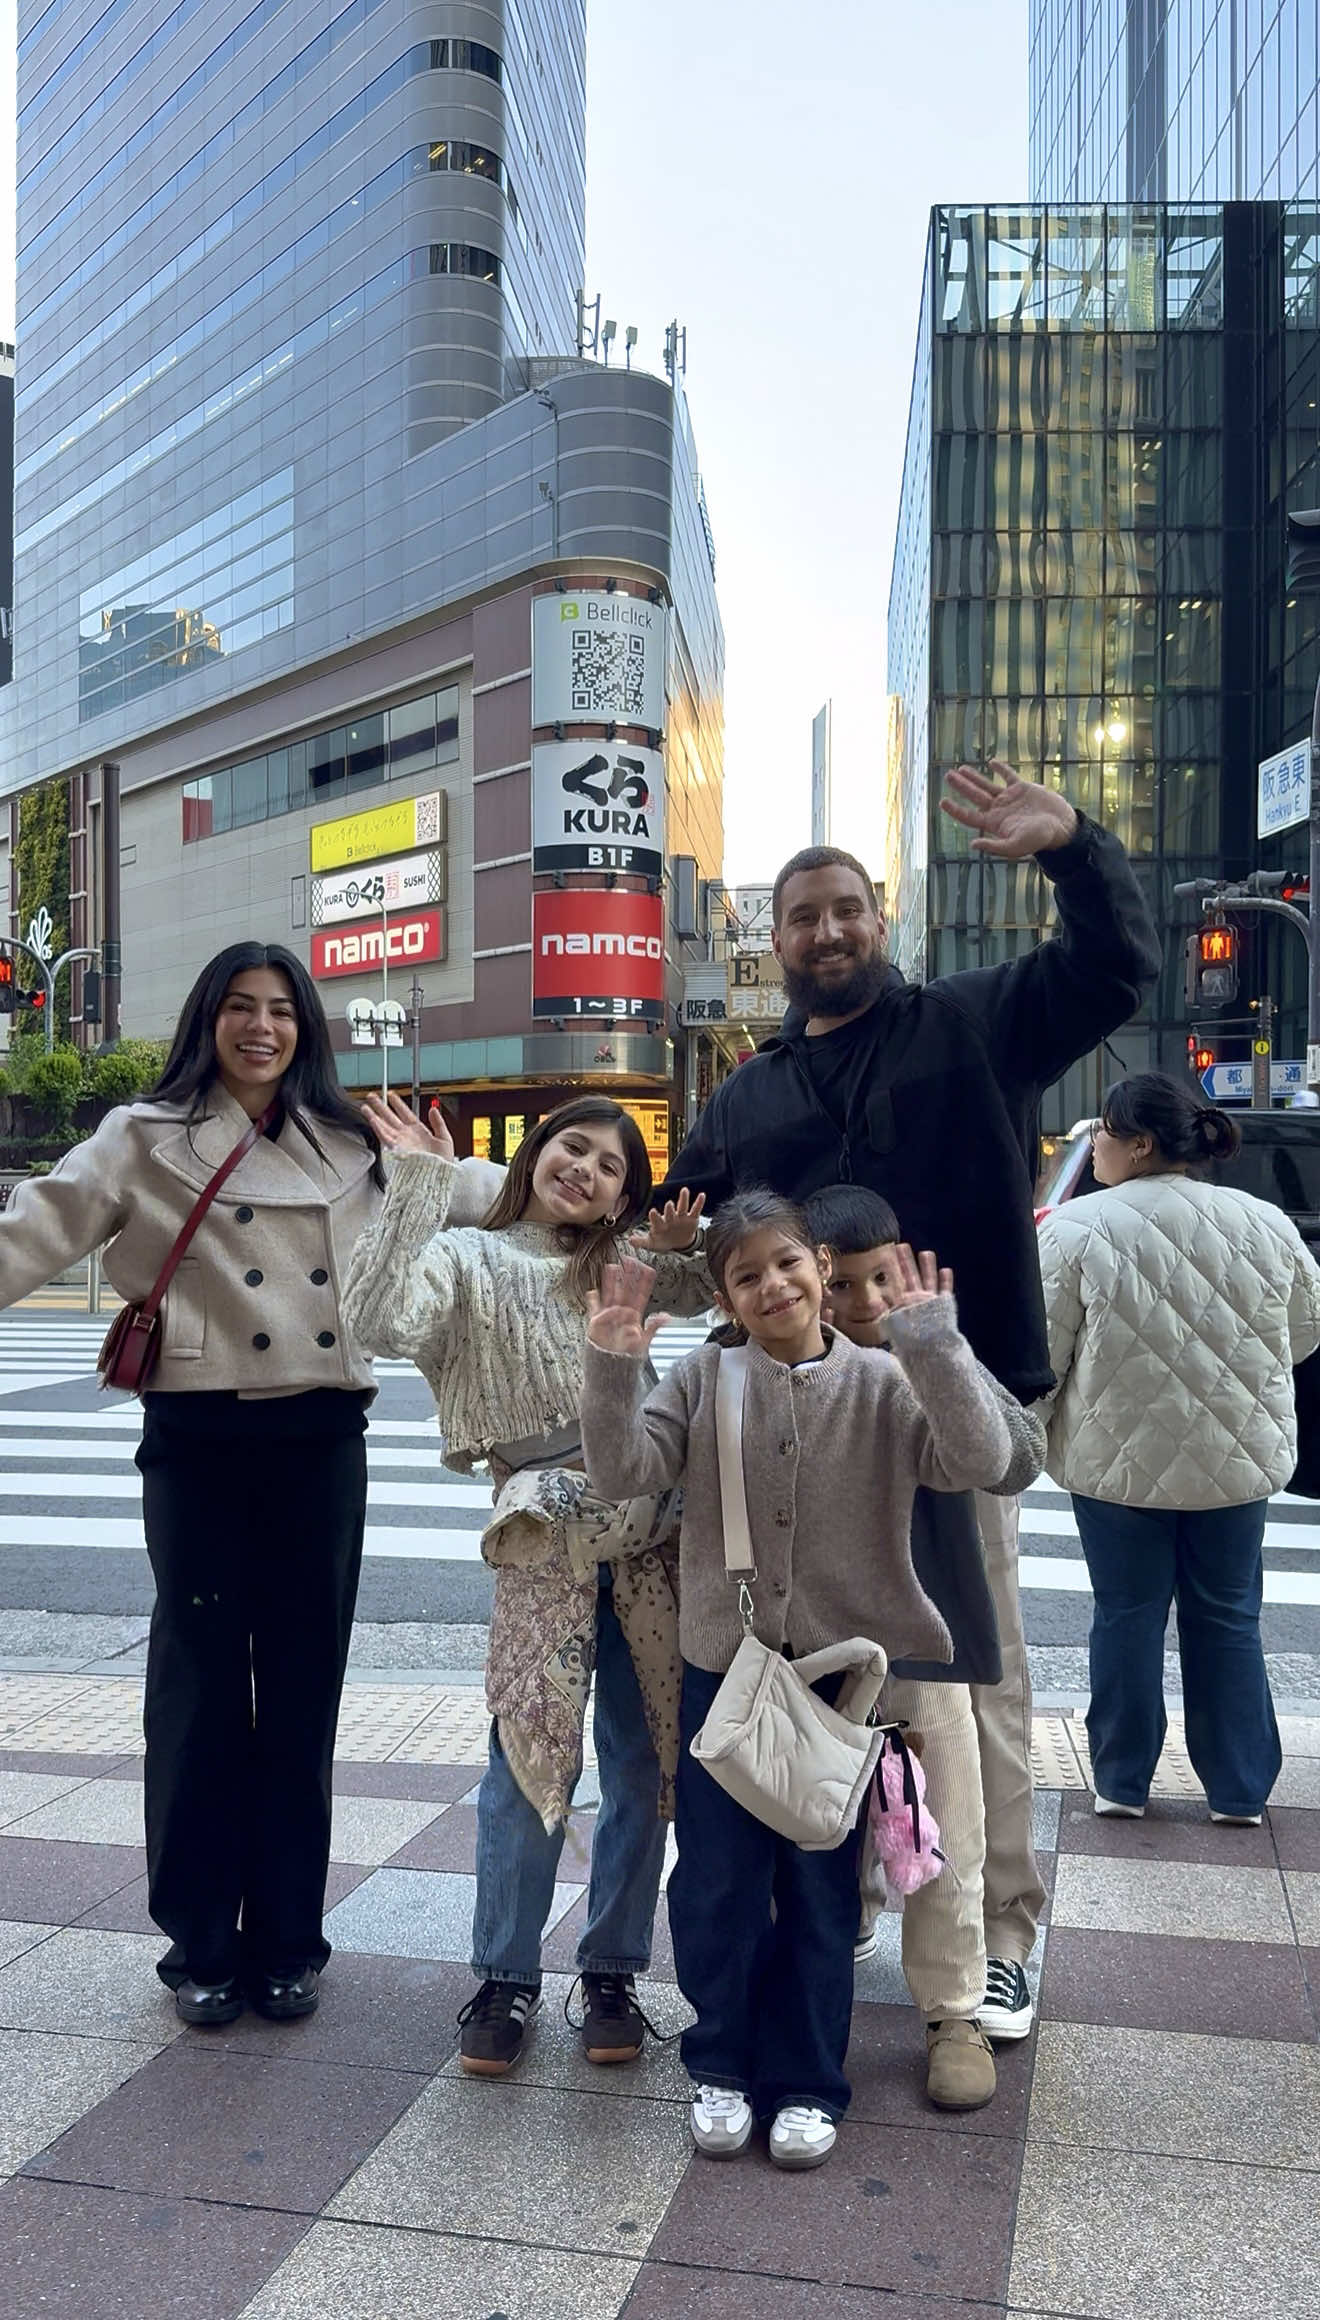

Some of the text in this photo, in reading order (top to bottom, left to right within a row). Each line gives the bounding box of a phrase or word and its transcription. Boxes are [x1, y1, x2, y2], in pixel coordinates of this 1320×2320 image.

[562, 753, 649, 808] くら
[1262, 753, 1306, 802] 阪急東
[564, 809, 650, 839] KURA
[1265, 794, 1301, 825] Hankyu E
[588, 846, 633, 867] B1F
[403, 873, 426, 889] SUSHI
[324, 894, 343, 907] KURA
[324, 923, 425, 968] namco
[542, 932, 662, 961] namco
[730, 958, 759, 987] E
[687, 988, 790, 1019] 阪急 東通
